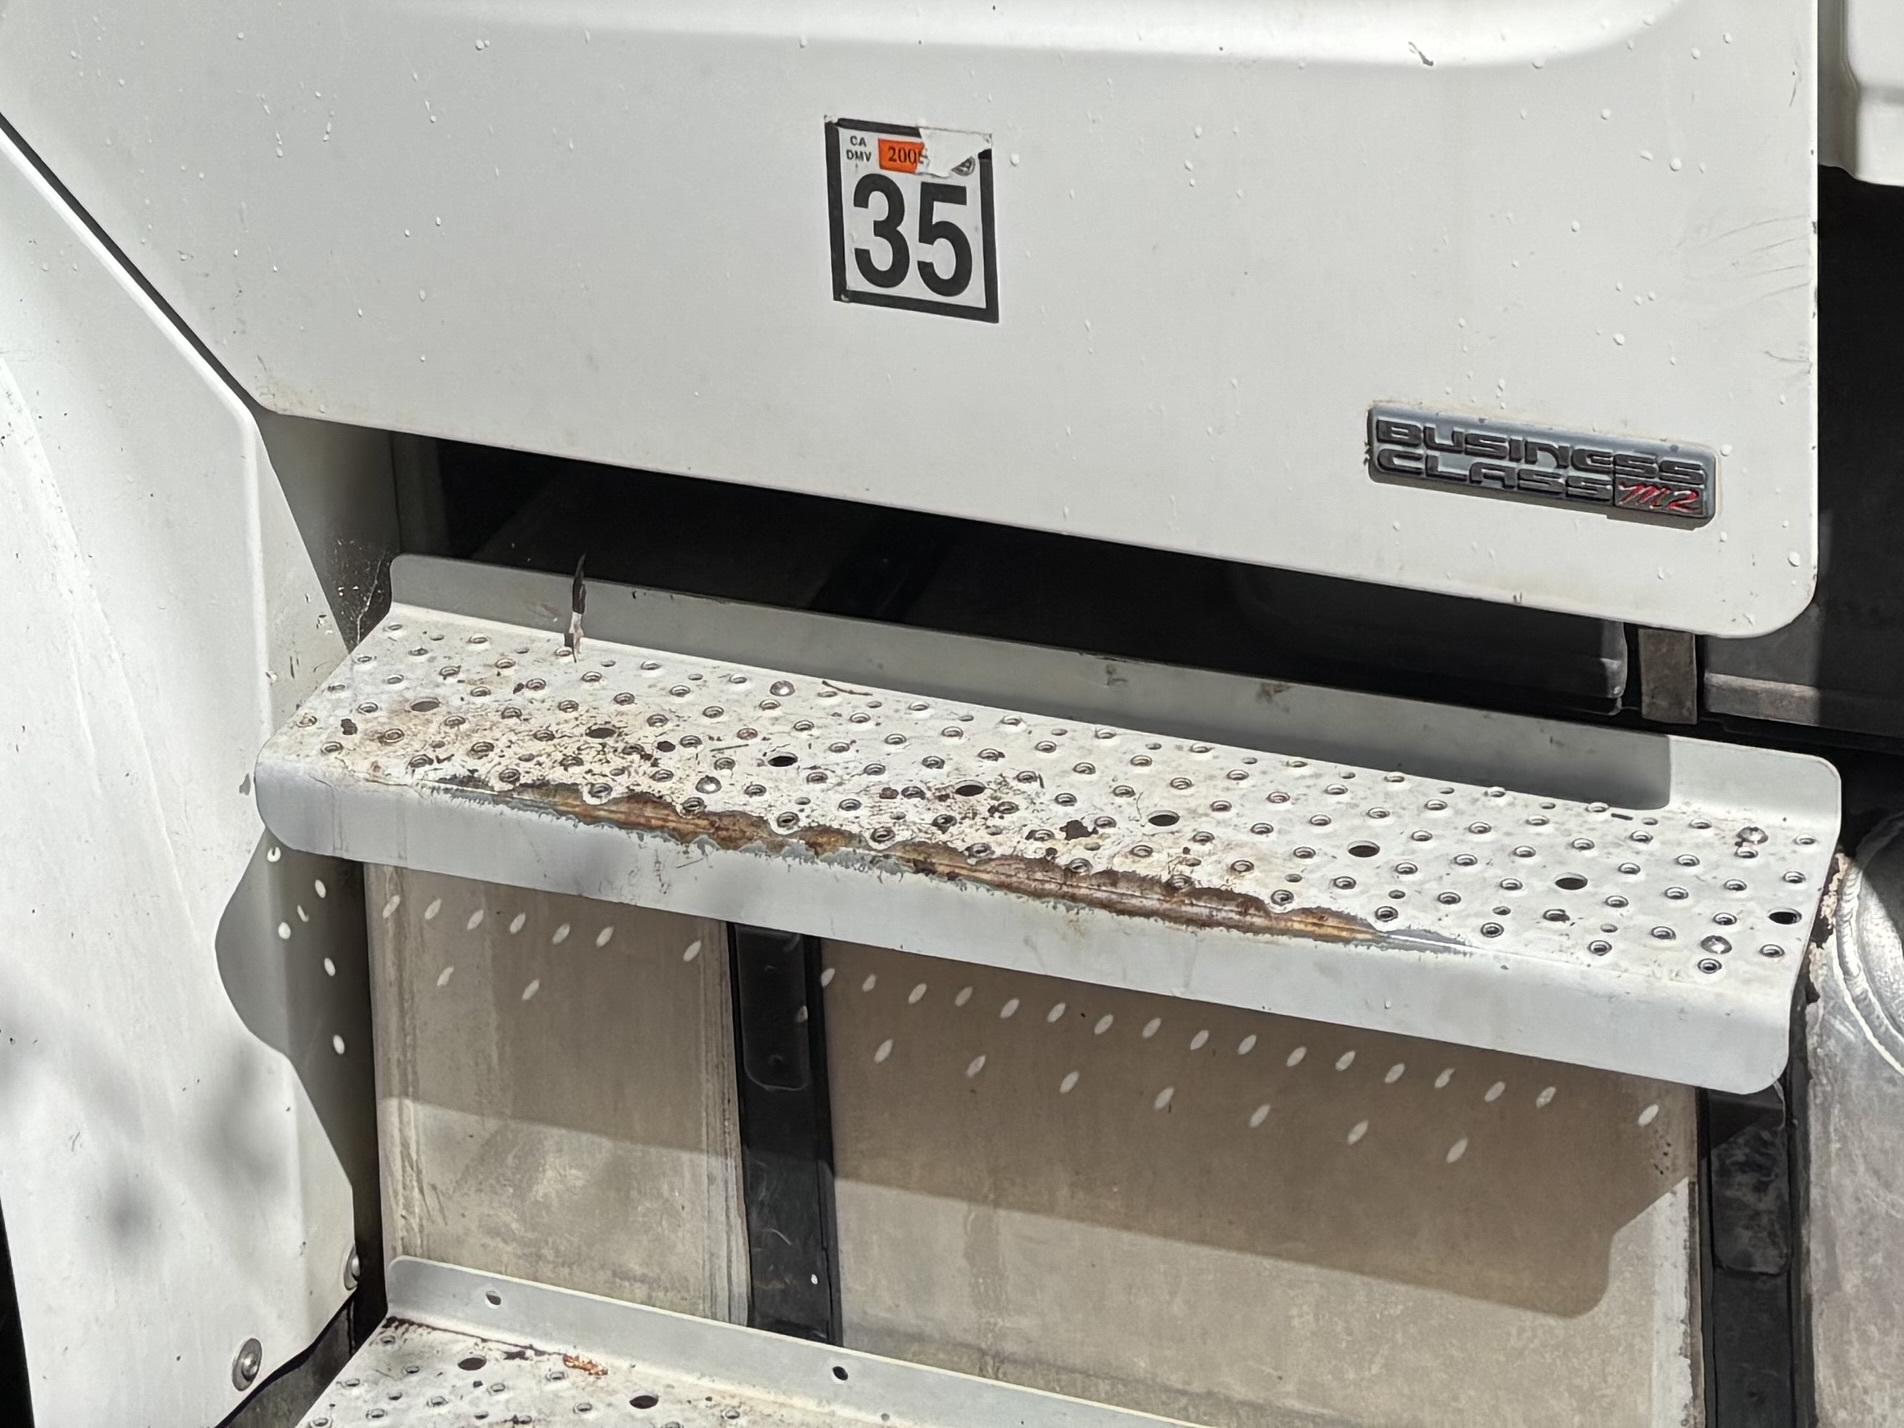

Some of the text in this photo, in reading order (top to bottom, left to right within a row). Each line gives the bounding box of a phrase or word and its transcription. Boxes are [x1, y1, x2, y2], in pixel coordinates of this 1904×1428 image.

[846, 149, 872, 162] DMV
[849, 135, 867, 148] CA
[853, 173, 973, 298] 35
[1376, 419, 1706, 486] BUSINESS
[1377, 447, 1614, 502] CLASS
